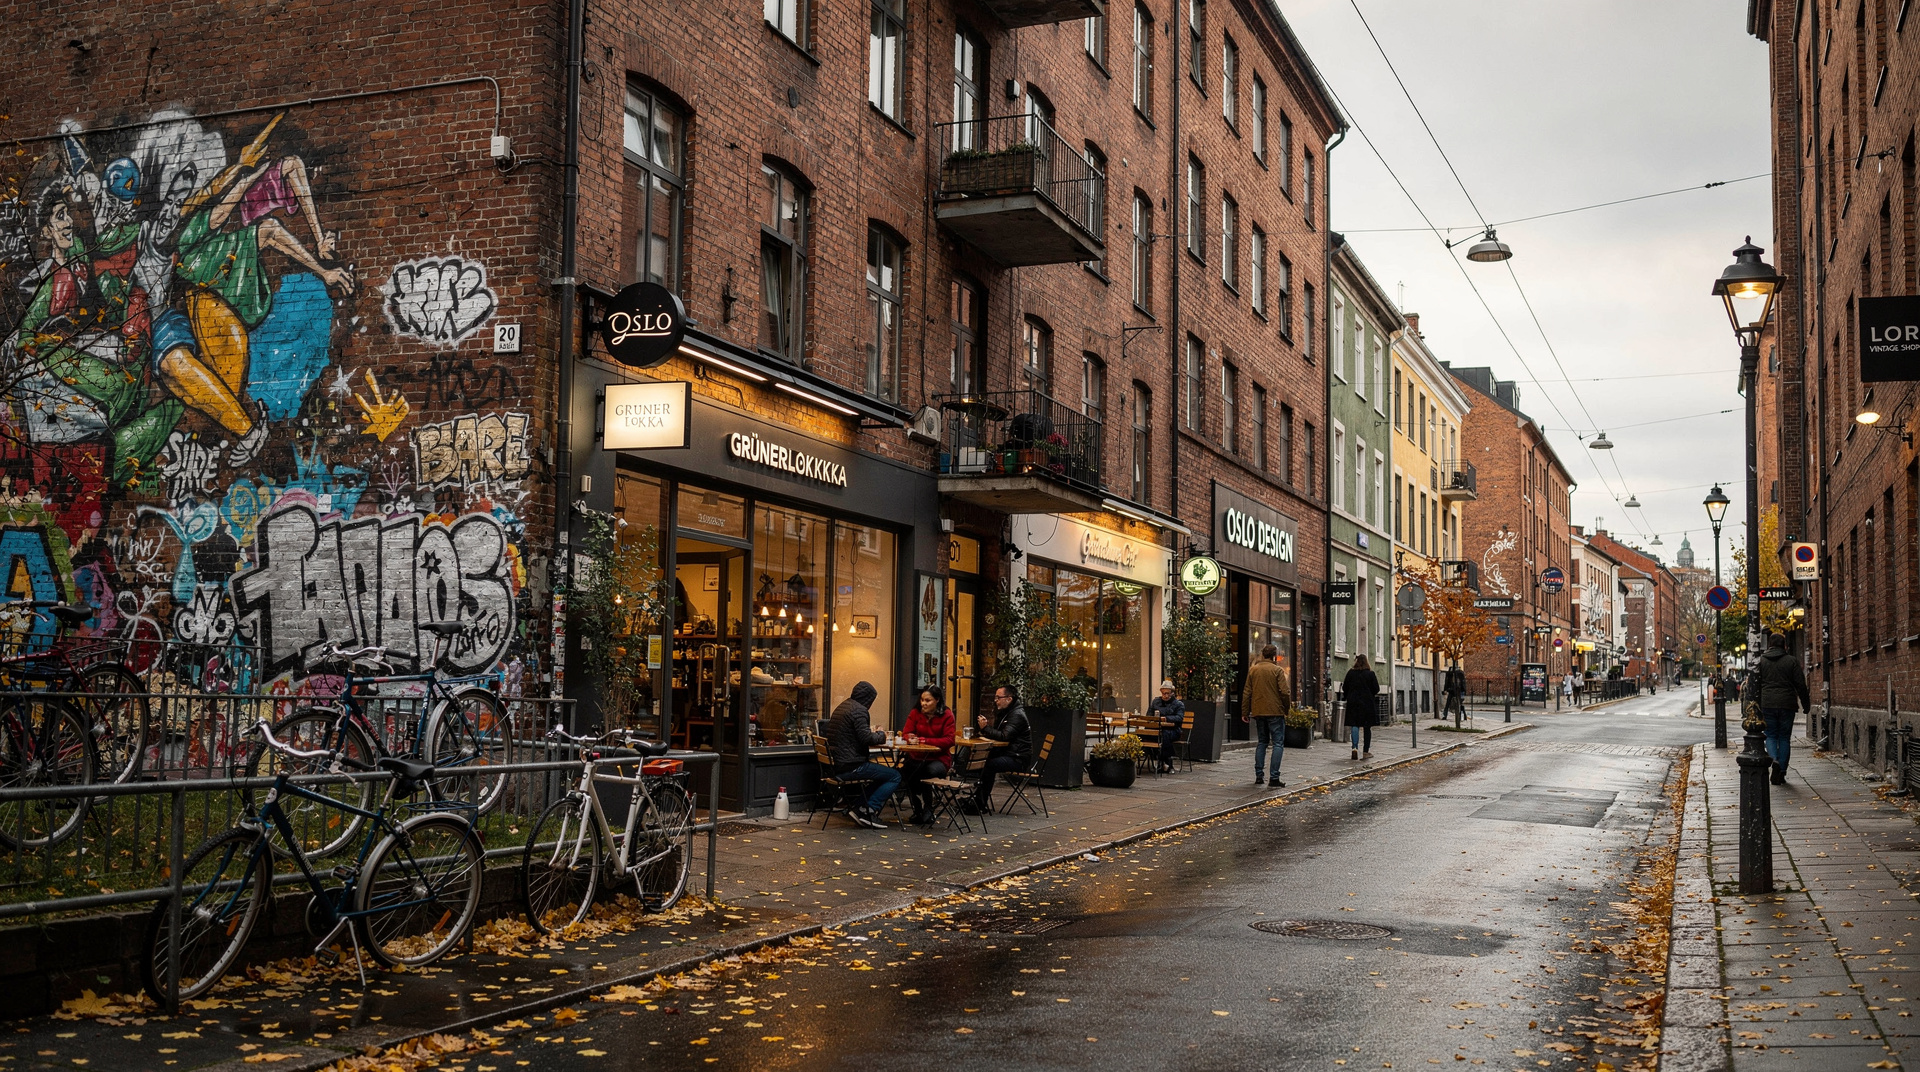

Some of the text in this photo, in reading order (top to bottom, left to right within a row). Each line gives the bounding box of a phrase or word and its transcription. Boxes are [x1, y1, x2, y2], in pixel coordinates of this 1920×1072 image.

[499, 326, 516, 342] 20
[608, 311, 672, 345] OSLO
[1870, 325, 1920, 342] LOR
[1869, 343, 1920, 352] VINTAGE SHOP
[615, 403, 671, 417] GRUNER
[625, 416, 664, 428] LOKKA
[1227, 507, 1294, 564] OSLO DESIGN
